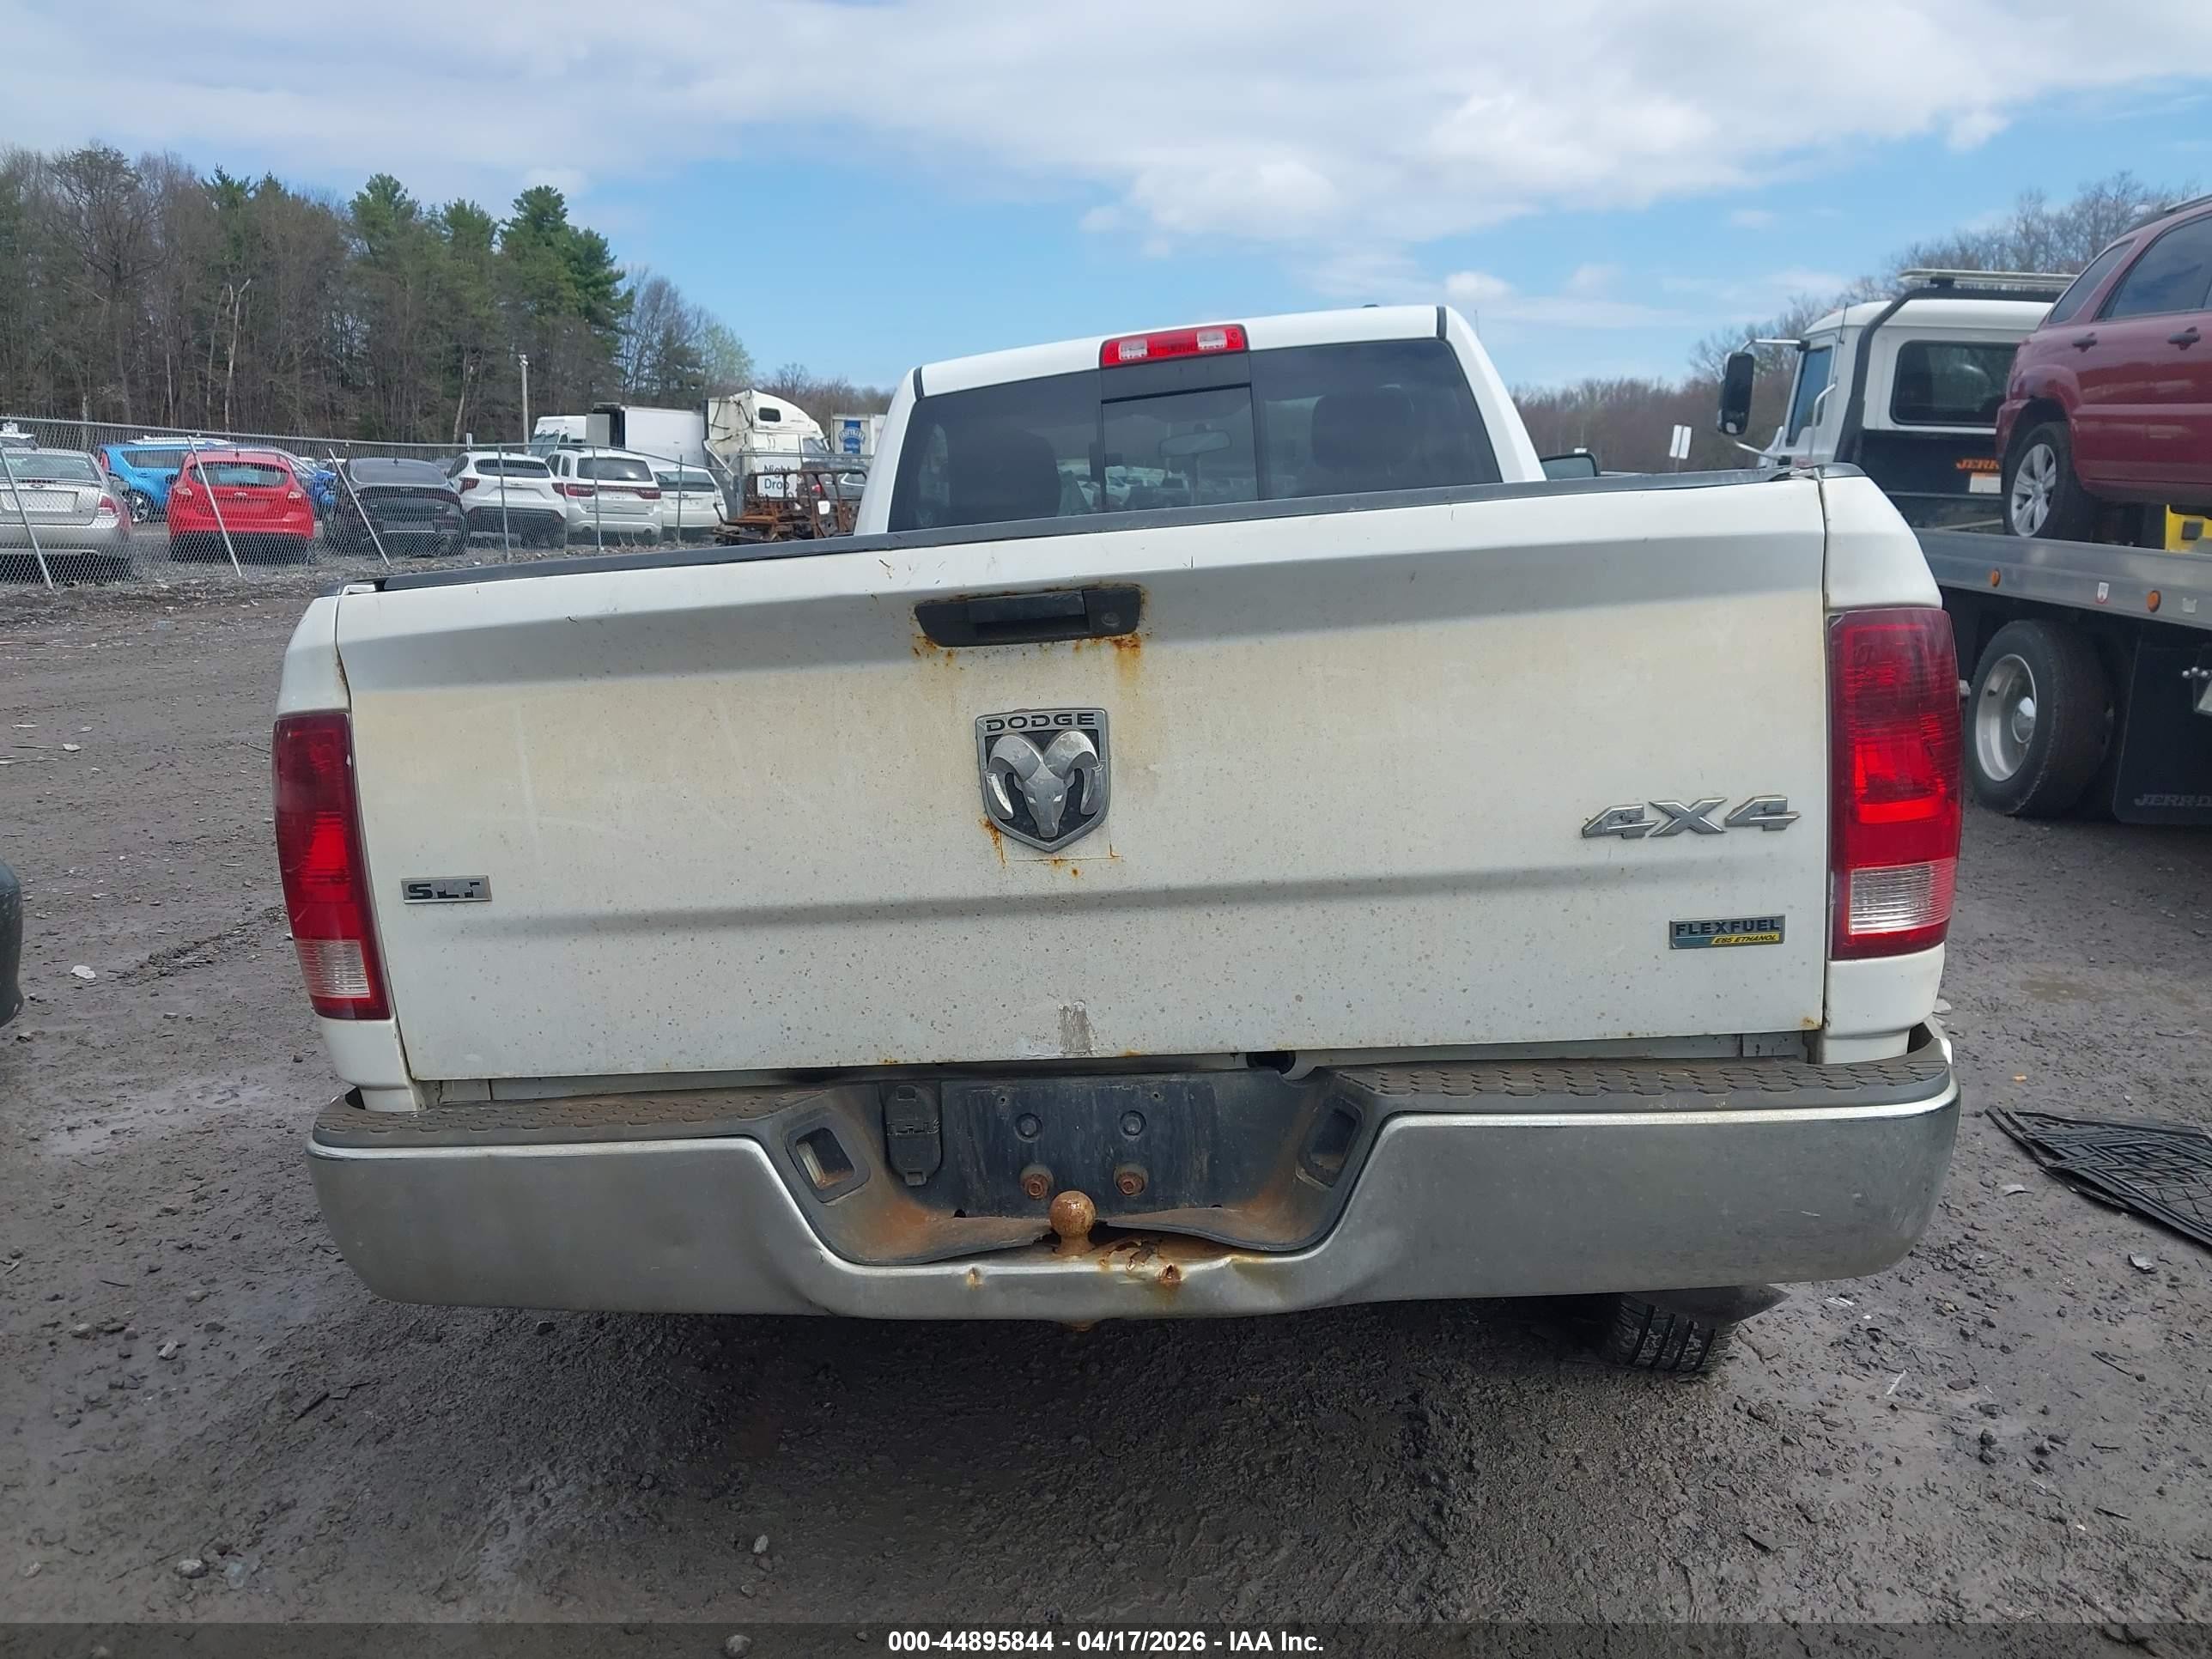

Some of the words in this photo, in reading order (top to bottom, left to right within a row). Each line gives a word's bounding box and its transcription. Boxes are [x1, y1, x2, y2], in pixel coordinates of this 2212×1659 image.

[985, 713, 1096, 731] DODGE
[1675, 918, 1781, 936] FLEXFUEL
[1735, 934, 1777, 943] ETHANOL
